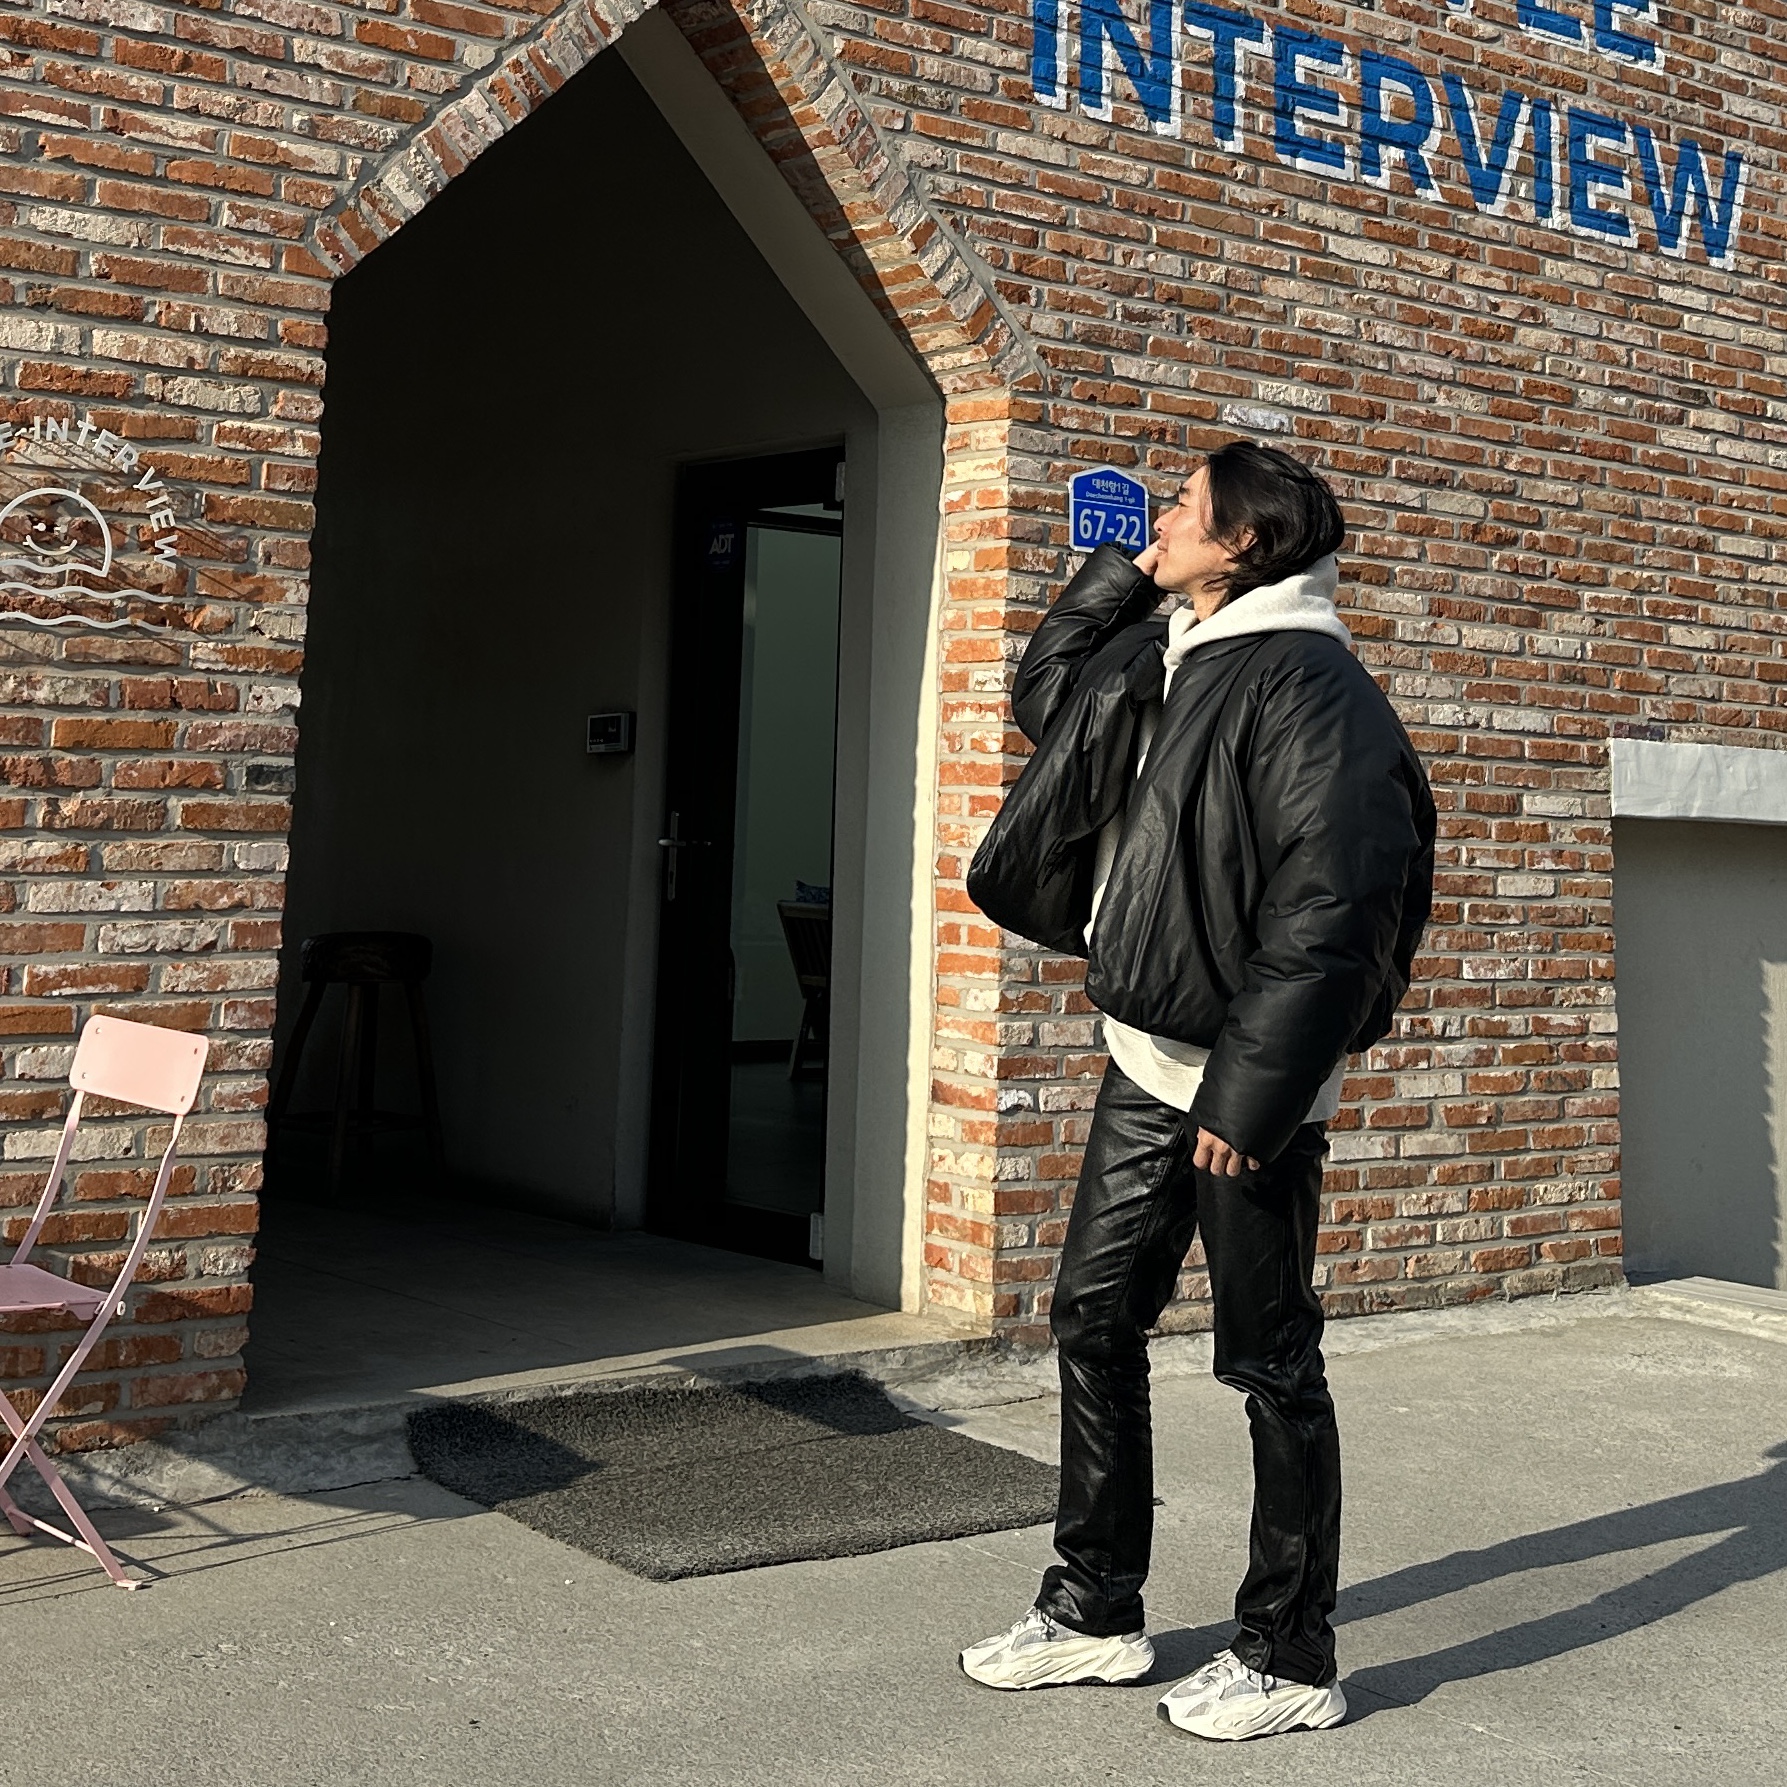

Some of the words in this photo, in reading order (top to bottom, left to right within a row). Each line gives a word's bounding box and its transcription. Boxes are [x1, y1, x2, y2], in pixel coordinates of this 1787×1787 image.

[1031, 0, 1749, 271] INTERVIEW
[33, 415, 178, 570] INTERVIEW
[1079, 508, 1142, 547] 67-22
[708, 533, 735, 555] ADT
